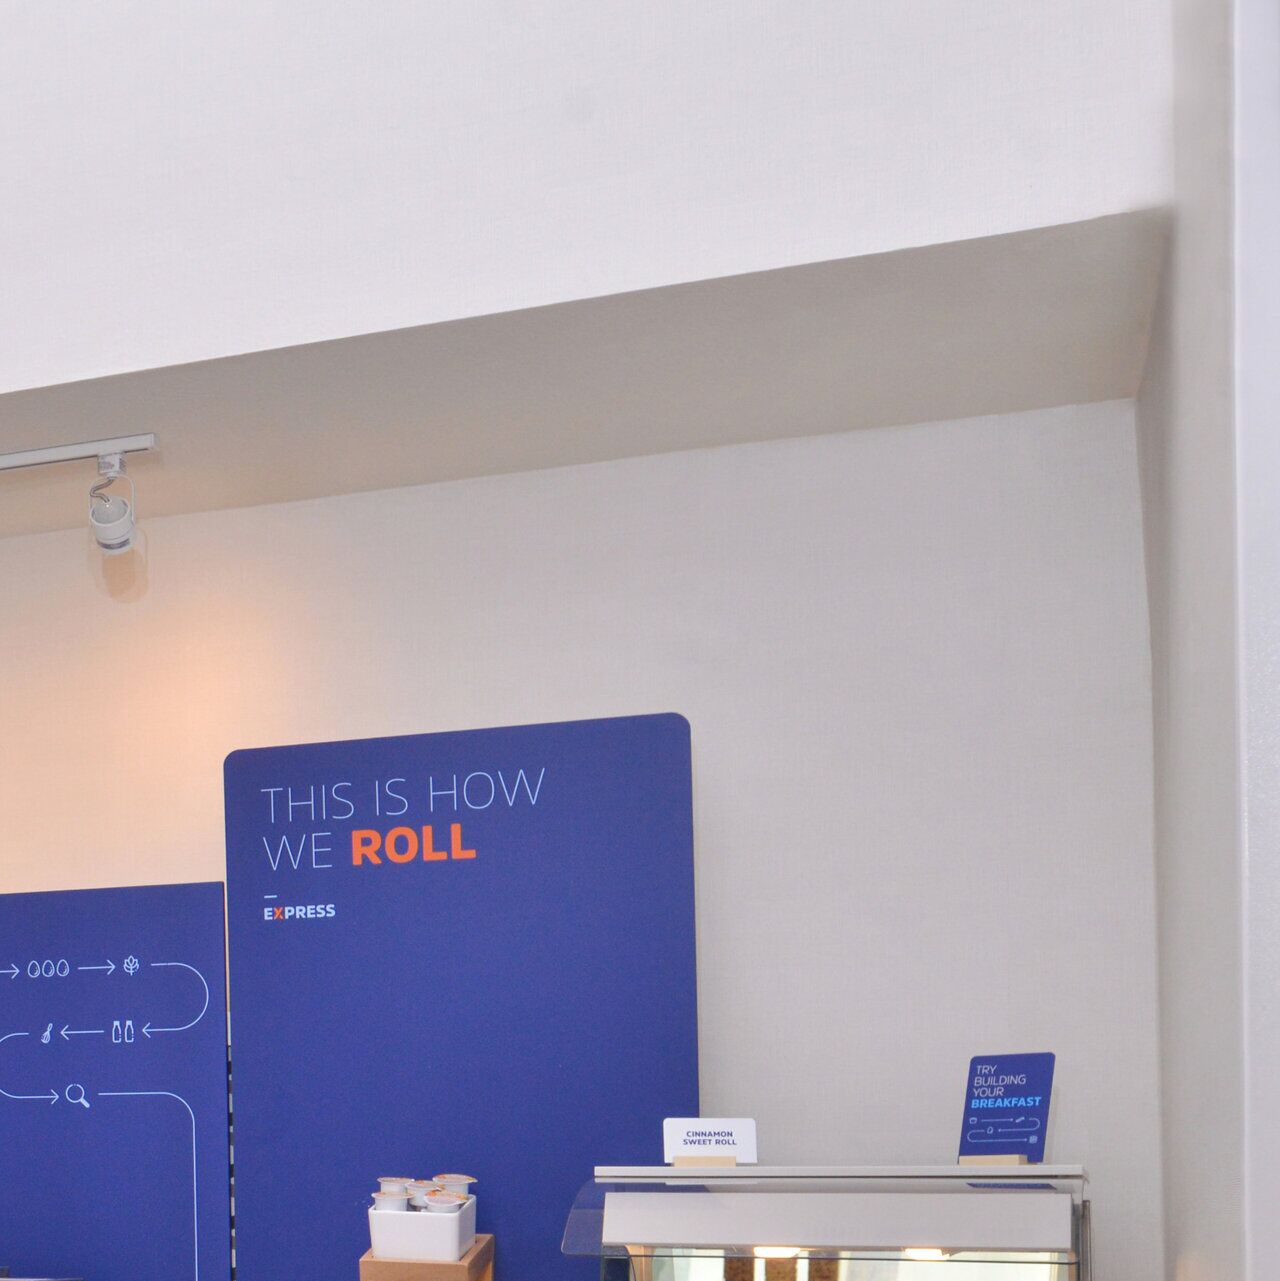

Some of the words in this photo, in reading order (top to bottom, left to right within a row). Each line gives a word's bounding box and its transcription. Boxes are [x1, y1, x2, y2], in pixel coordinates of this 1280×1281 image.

[260, 782, 354, 824] THIS
[375, 778, 408, 816] IS
[429, 767, 546, 813] HOW
[262, 832, 333, 871] WE
[351, 823, 477, 866] ROLL
[263, 903, 336, 921] EXPRESS
[976, 1065, 997, 1075] TRY
[974, 1074, 1027, 1087] BUILDING
[973, 1086, 1005, 1098] YOUR
[970, 1096, 1042, 1109] BREAKFAST
